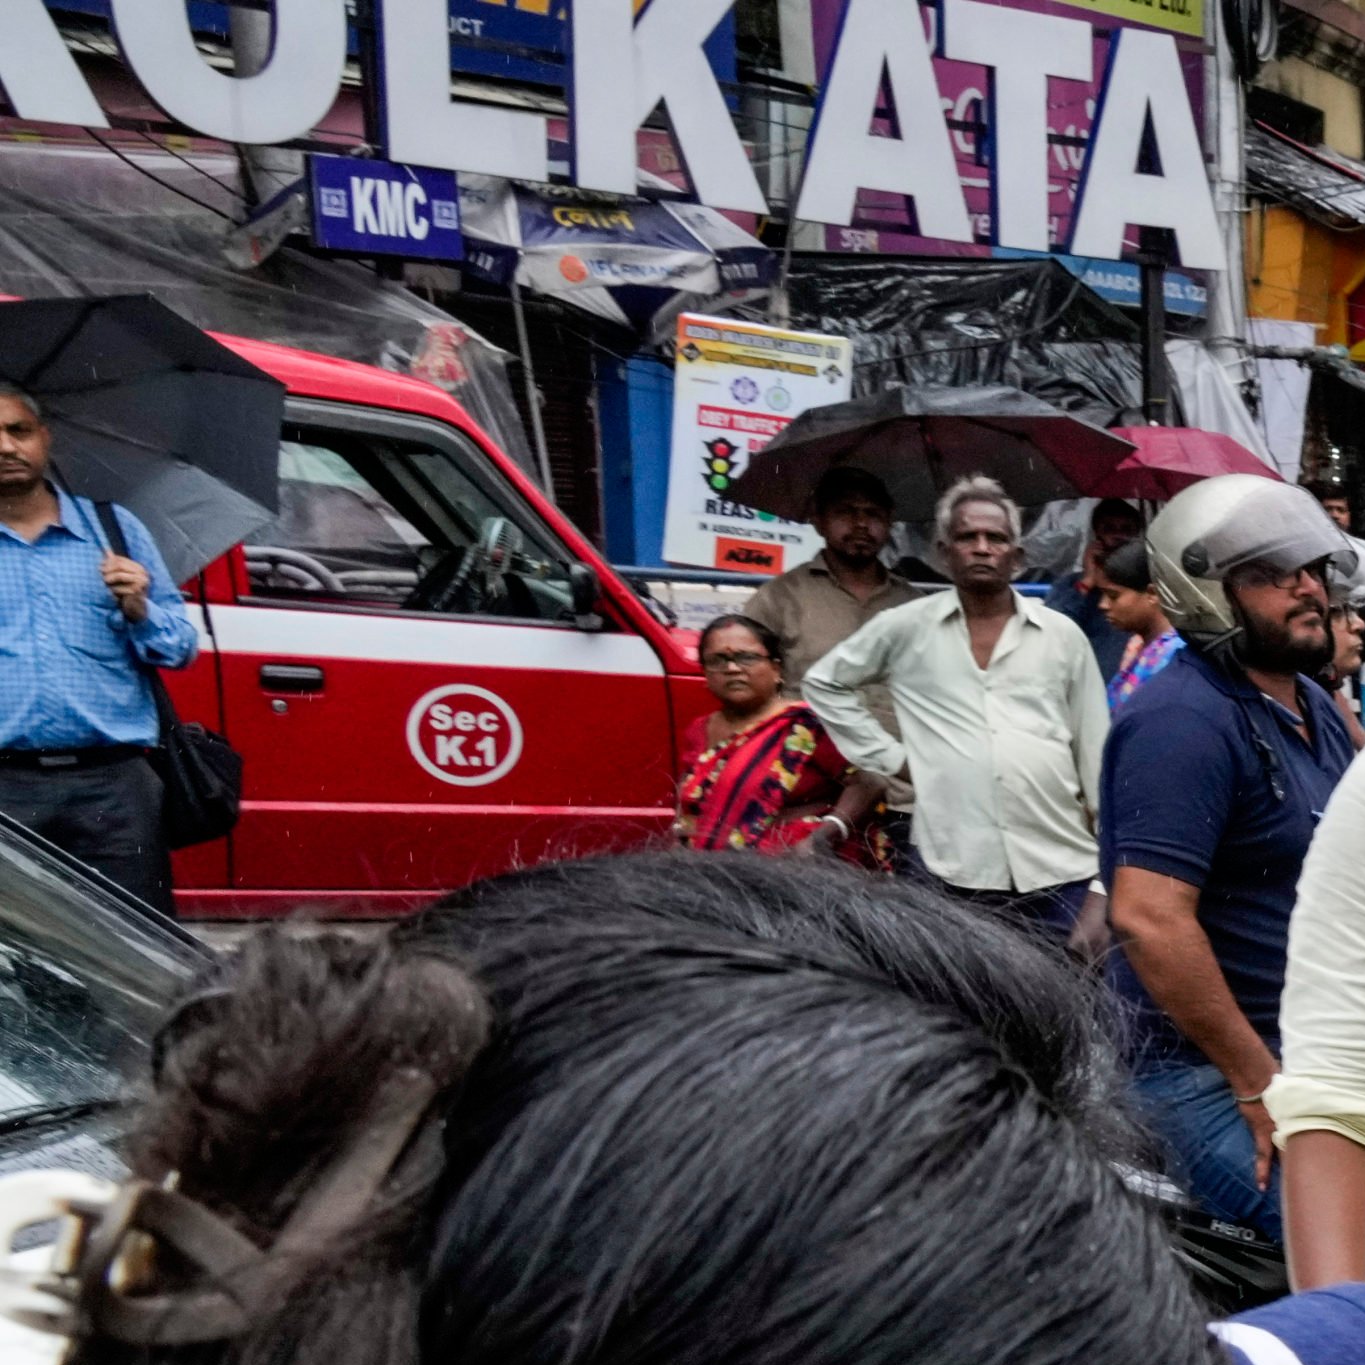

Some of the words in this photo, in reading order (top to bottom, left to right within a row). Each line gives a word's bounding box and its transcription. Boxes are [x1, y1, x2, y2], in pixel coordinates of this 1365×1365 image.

[351, 176, 429, 241] KMC
[724, 547, 774, 567] KTM
[429, 703, 500, 733] Sec
[435, 734, 497, 767] K.1
